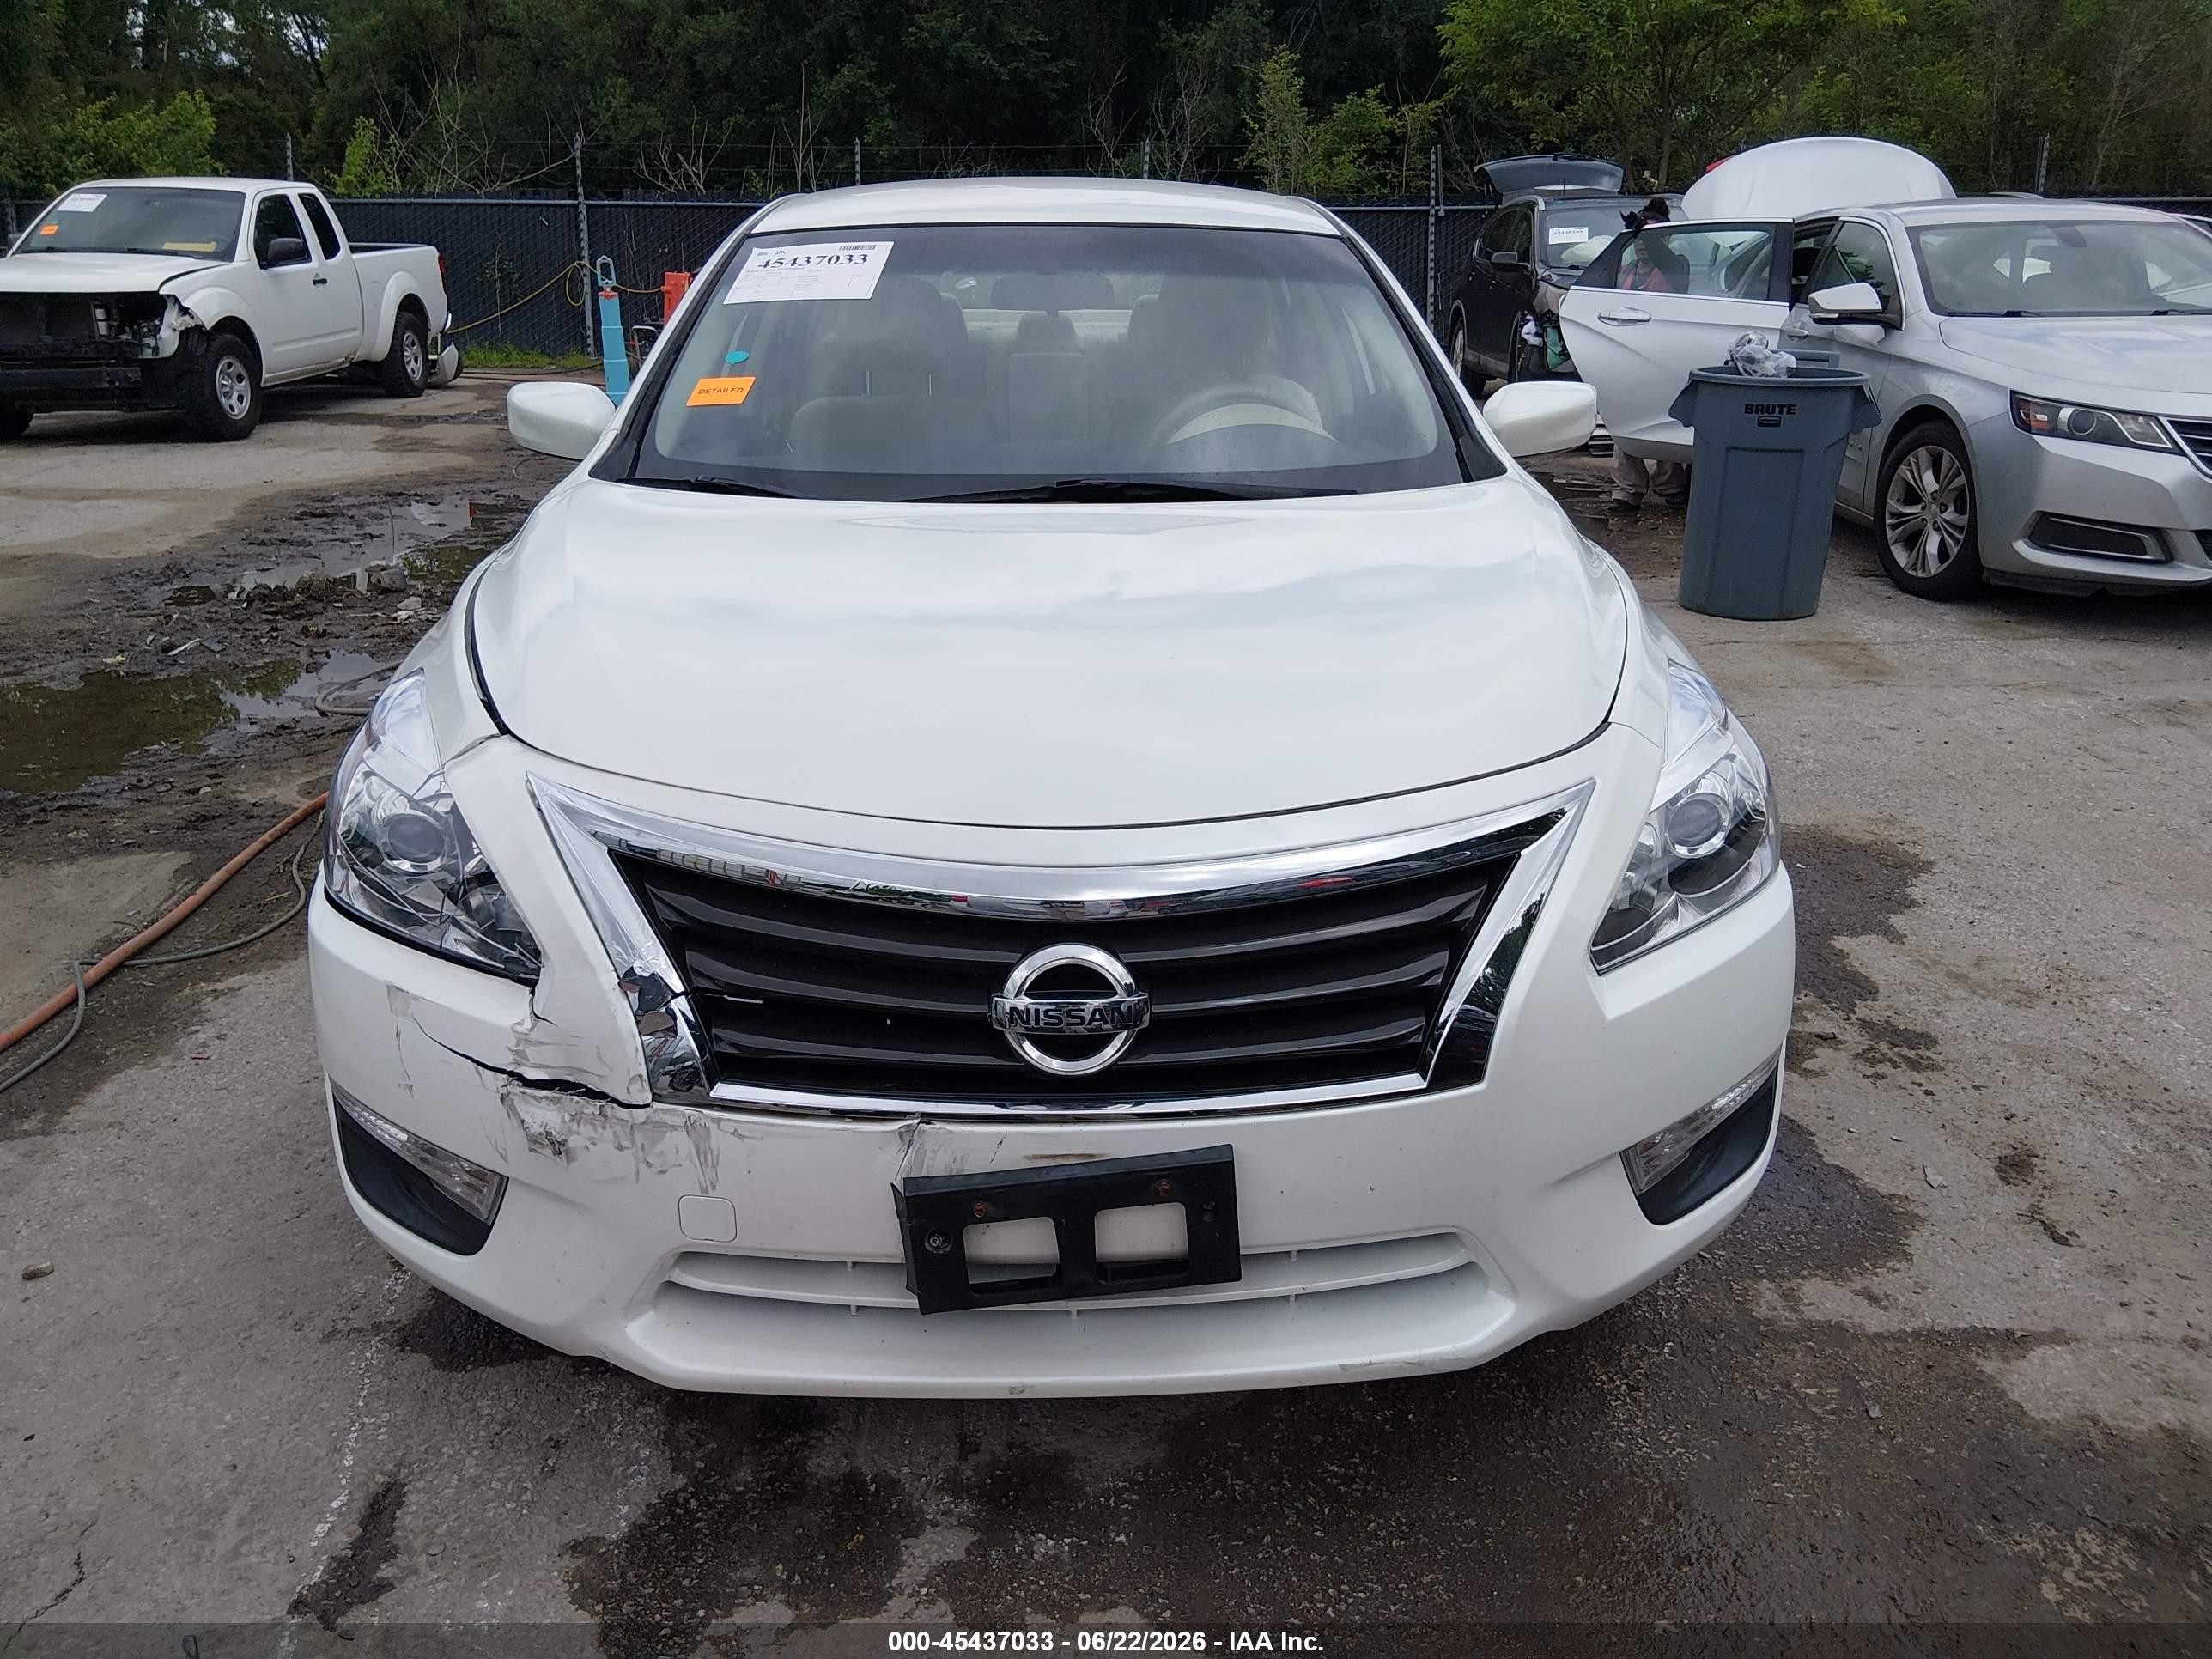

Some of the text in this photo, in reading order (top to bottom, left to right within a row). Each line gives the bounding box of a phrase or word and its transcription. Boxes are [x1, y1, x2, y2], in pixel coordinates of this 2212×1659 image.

[757, 253, 869, 269] 45437033
[1744, 404, 1797, 416] BRUTE
[1008, 1006, 1133, 1028] NISSAN
